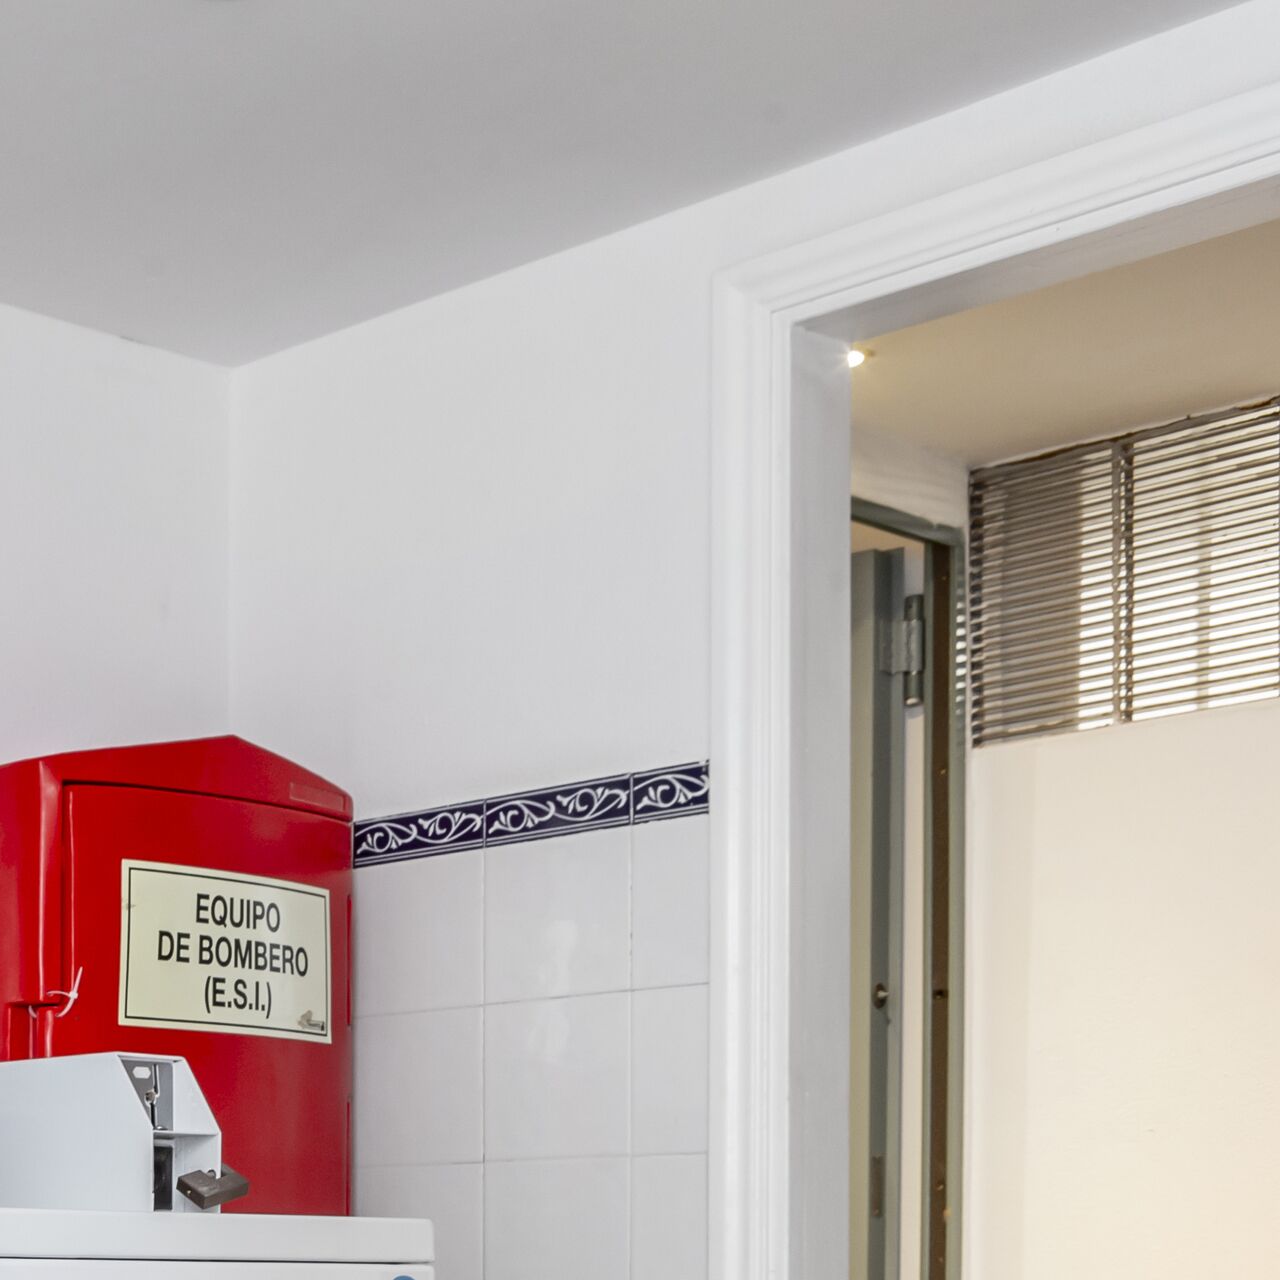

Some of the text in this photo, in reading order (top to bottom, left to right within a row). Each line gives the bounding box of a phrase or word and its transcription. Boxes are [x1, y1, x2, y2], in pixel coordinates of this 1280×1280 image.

[196, 893, 281, 933] EQUIPO
[157, 931, 309, 977] DE BOMBERO
[204, 976, 272, 1019] (E.S.I.)
